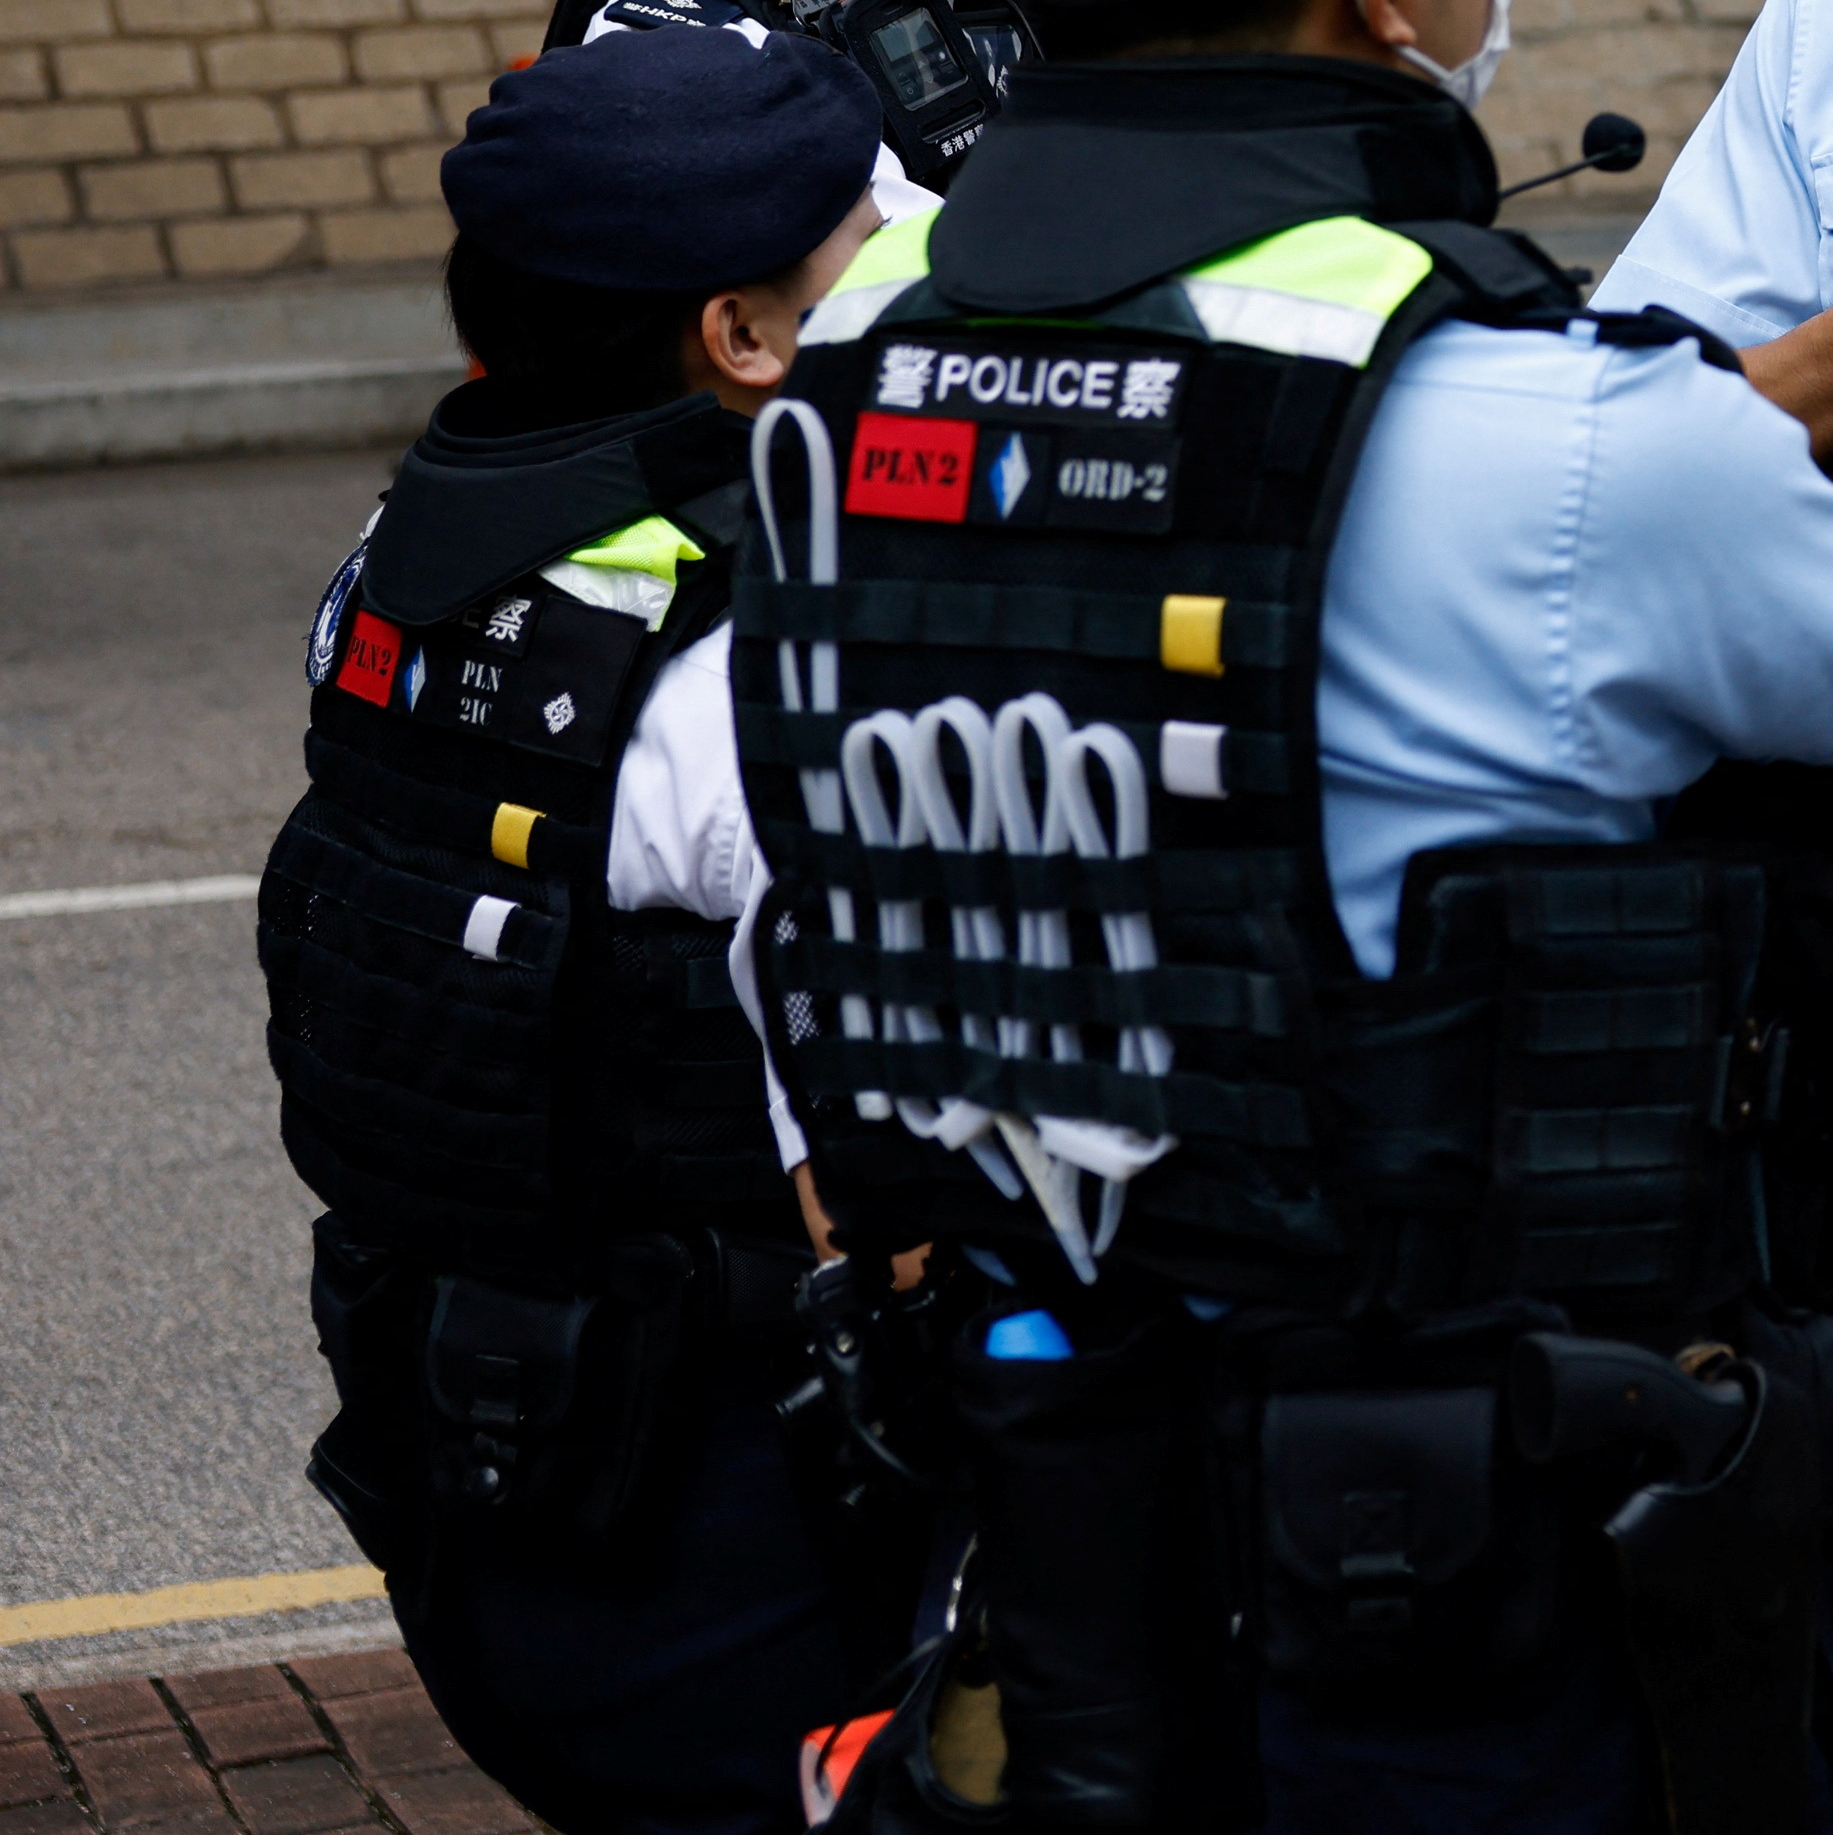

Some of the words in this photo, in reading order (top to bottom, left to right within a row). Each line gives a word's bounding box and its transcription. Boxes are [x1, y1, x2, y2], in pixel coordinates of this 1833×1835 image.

[877, 343, 938, 409] 警
[935, 353, 1120, 409] POLICE
[1117, 358, 1181, 419] 察
[1058, 458, 1168, 503] ORD-2
[485, 594, 533, 643] 察
[461, 660, 504, 693] PLN
